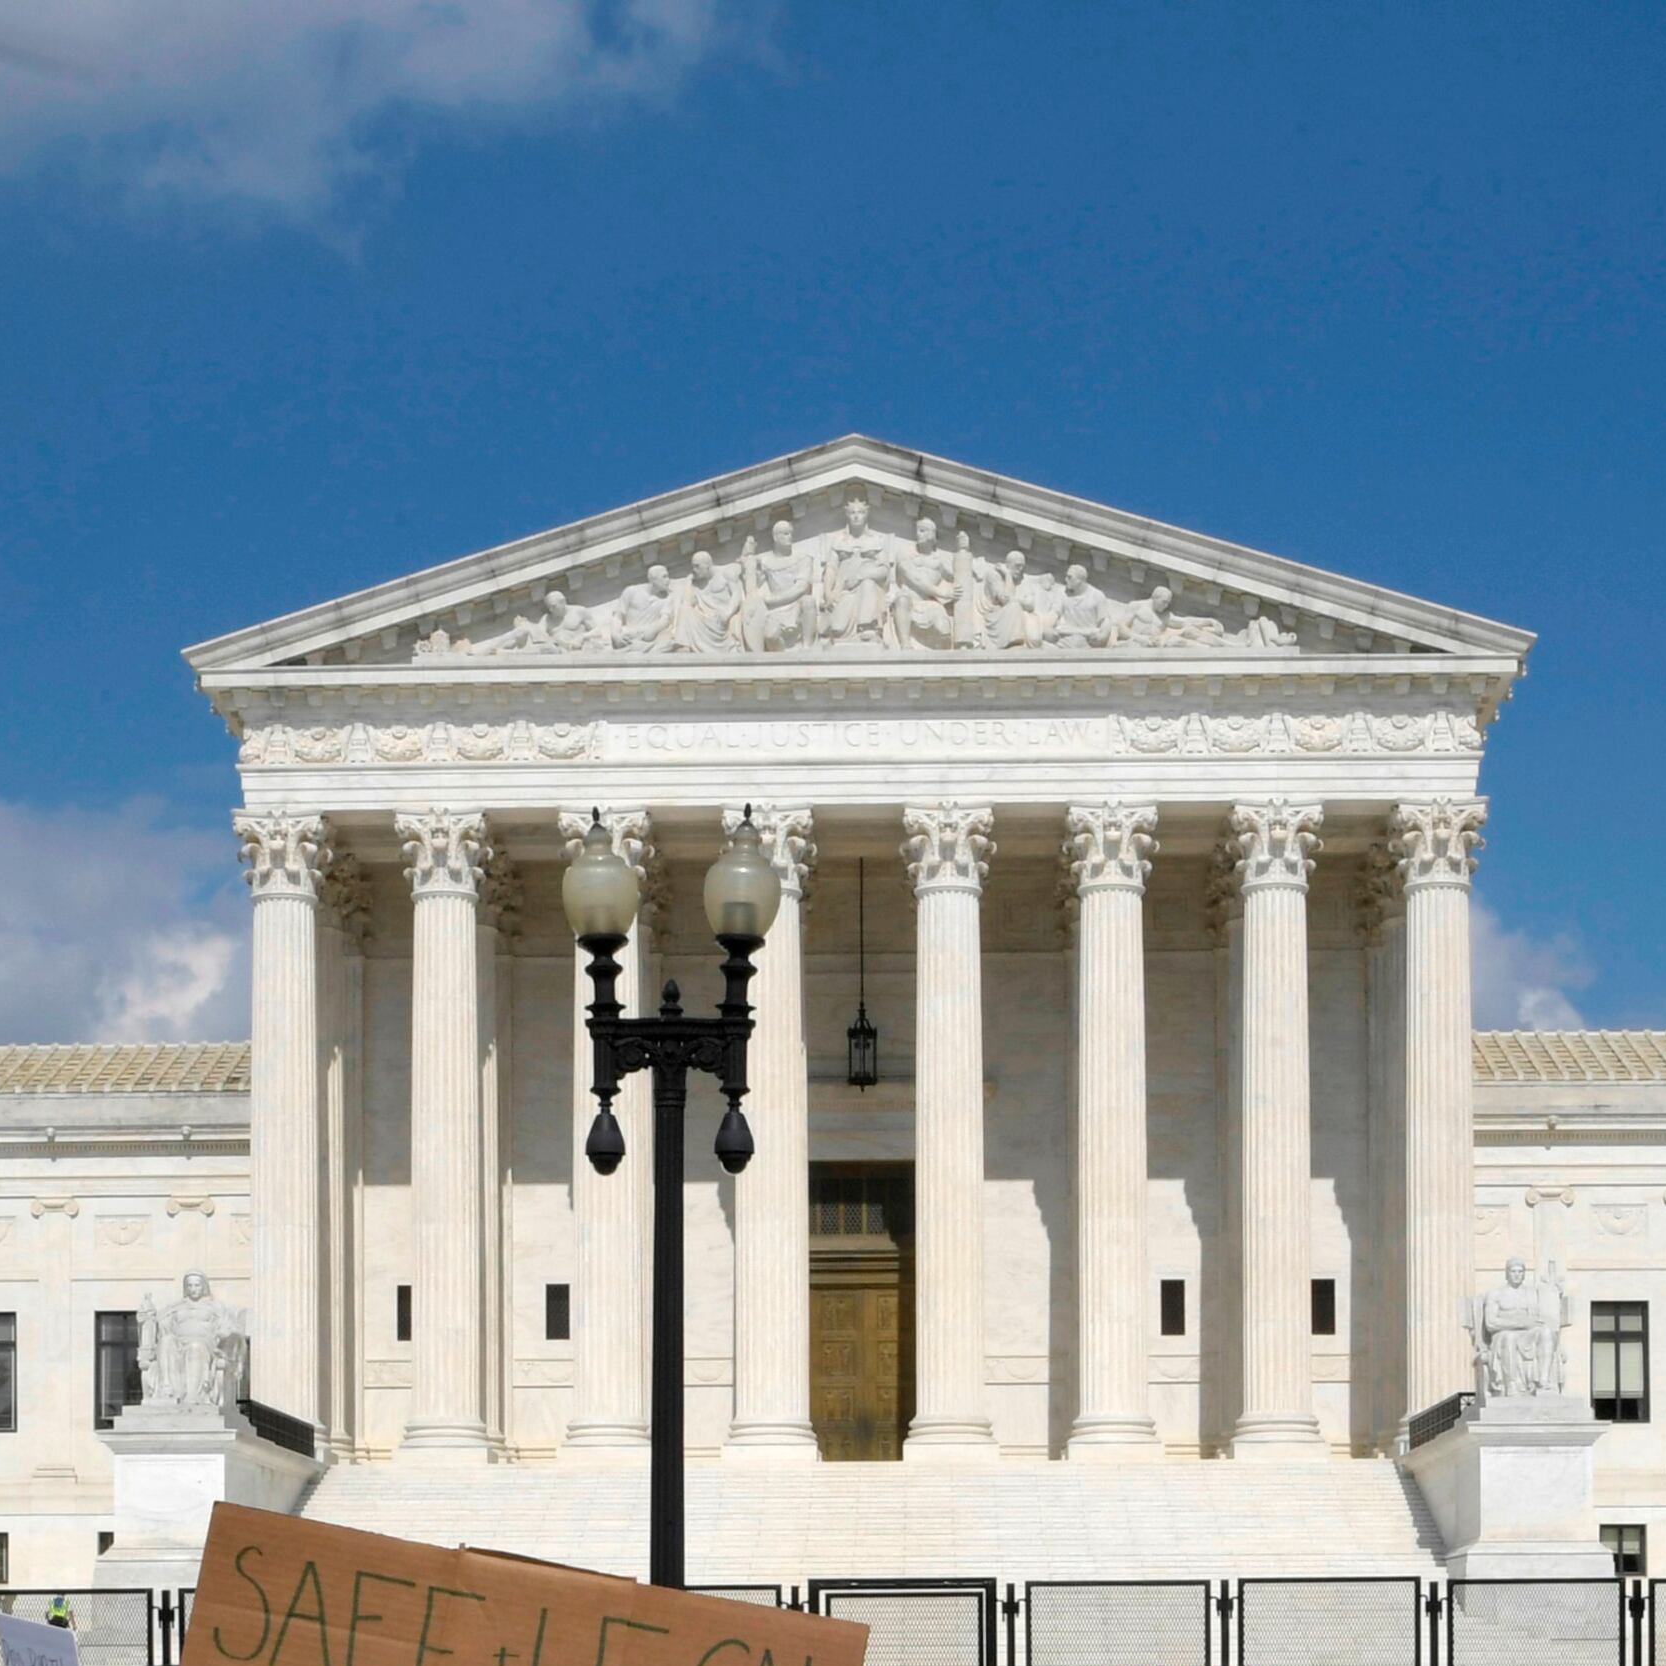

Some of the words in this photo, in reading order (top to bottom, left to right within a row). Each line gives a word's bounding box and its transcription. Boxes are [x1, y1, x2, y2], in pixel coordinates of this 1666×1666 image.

[626, 724, 739, 751] EQUAL
[750, 723, 879, 748] JUSTICE
[898, 721, 1013, 747] UNDER
[1025, 721, 1091, 746] LAW
